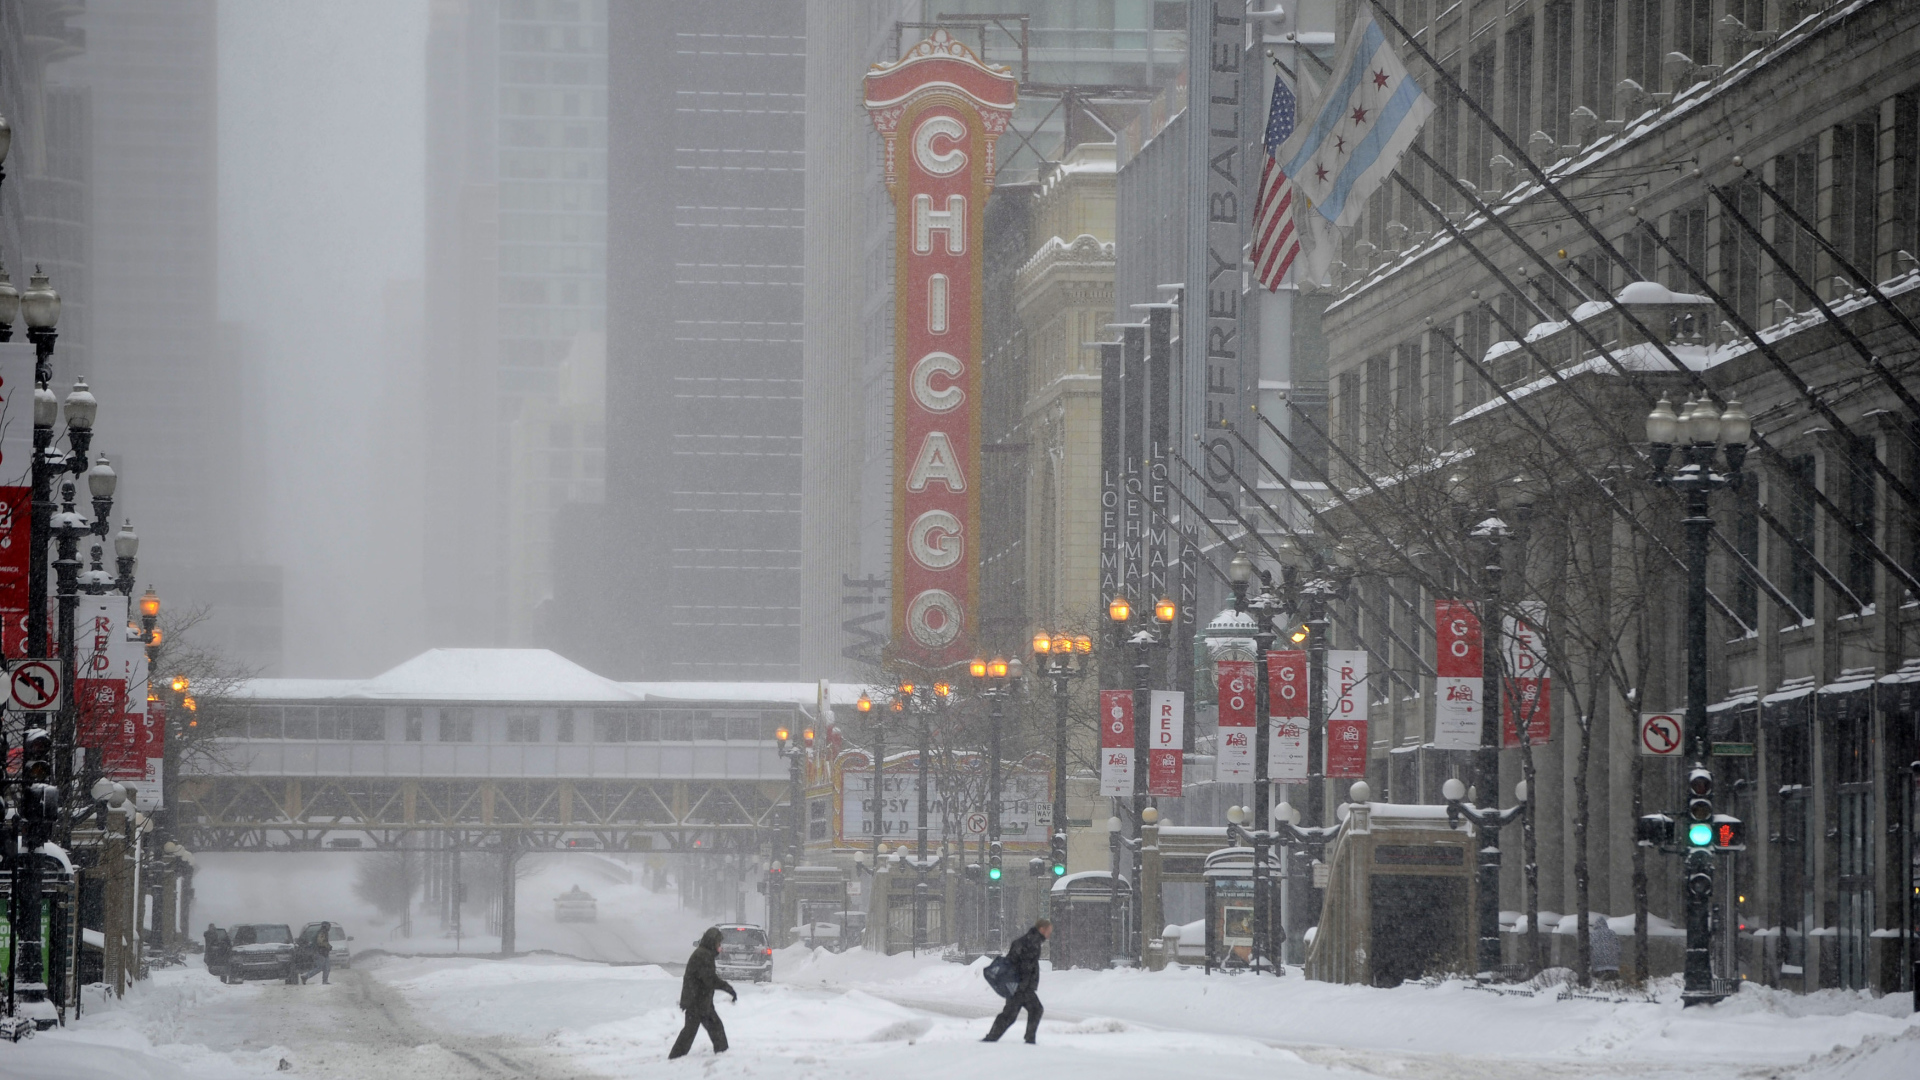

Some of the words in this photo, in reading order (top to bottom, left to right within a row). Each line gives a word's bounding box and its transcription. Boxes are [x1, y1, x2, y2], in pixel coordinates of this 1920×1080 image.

[1210, 2, 1240, 224] BALLET
[907, 115, 969, 650] CHICAGO
[1207, 249, 1237, 516] JOFFREY
[93, 616, 110, 671] RED
[1451, 619, 1468, 657] GO
[1230, 679, 1244, 710] GO
[1281, 667, 1296, 700] GO
[1341, 667, 1354, 713] RED
[1160, 704, 1172, 744] RED
